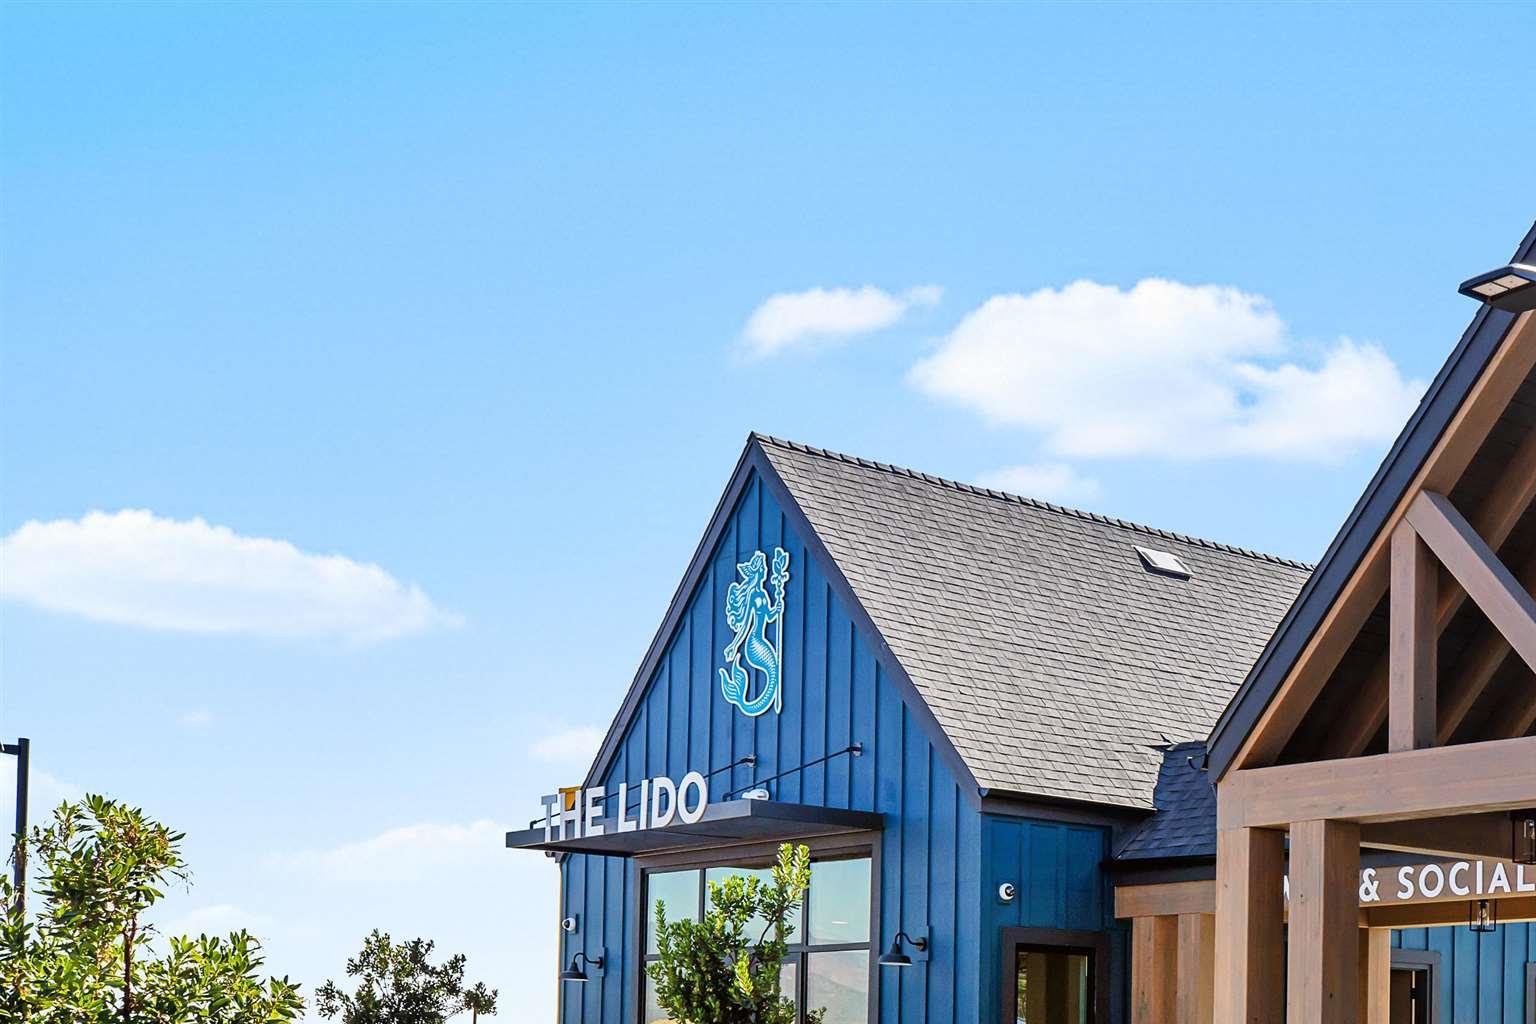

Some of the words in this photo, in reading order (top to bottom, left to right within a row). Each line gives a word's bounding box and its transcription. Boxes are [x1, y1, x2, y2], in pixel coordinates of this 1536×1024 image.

[541, 786, 605, 843] THE
[617, 771, 708, 833] LIDO
[1396, 860, 1536, 900] SOCIAL
